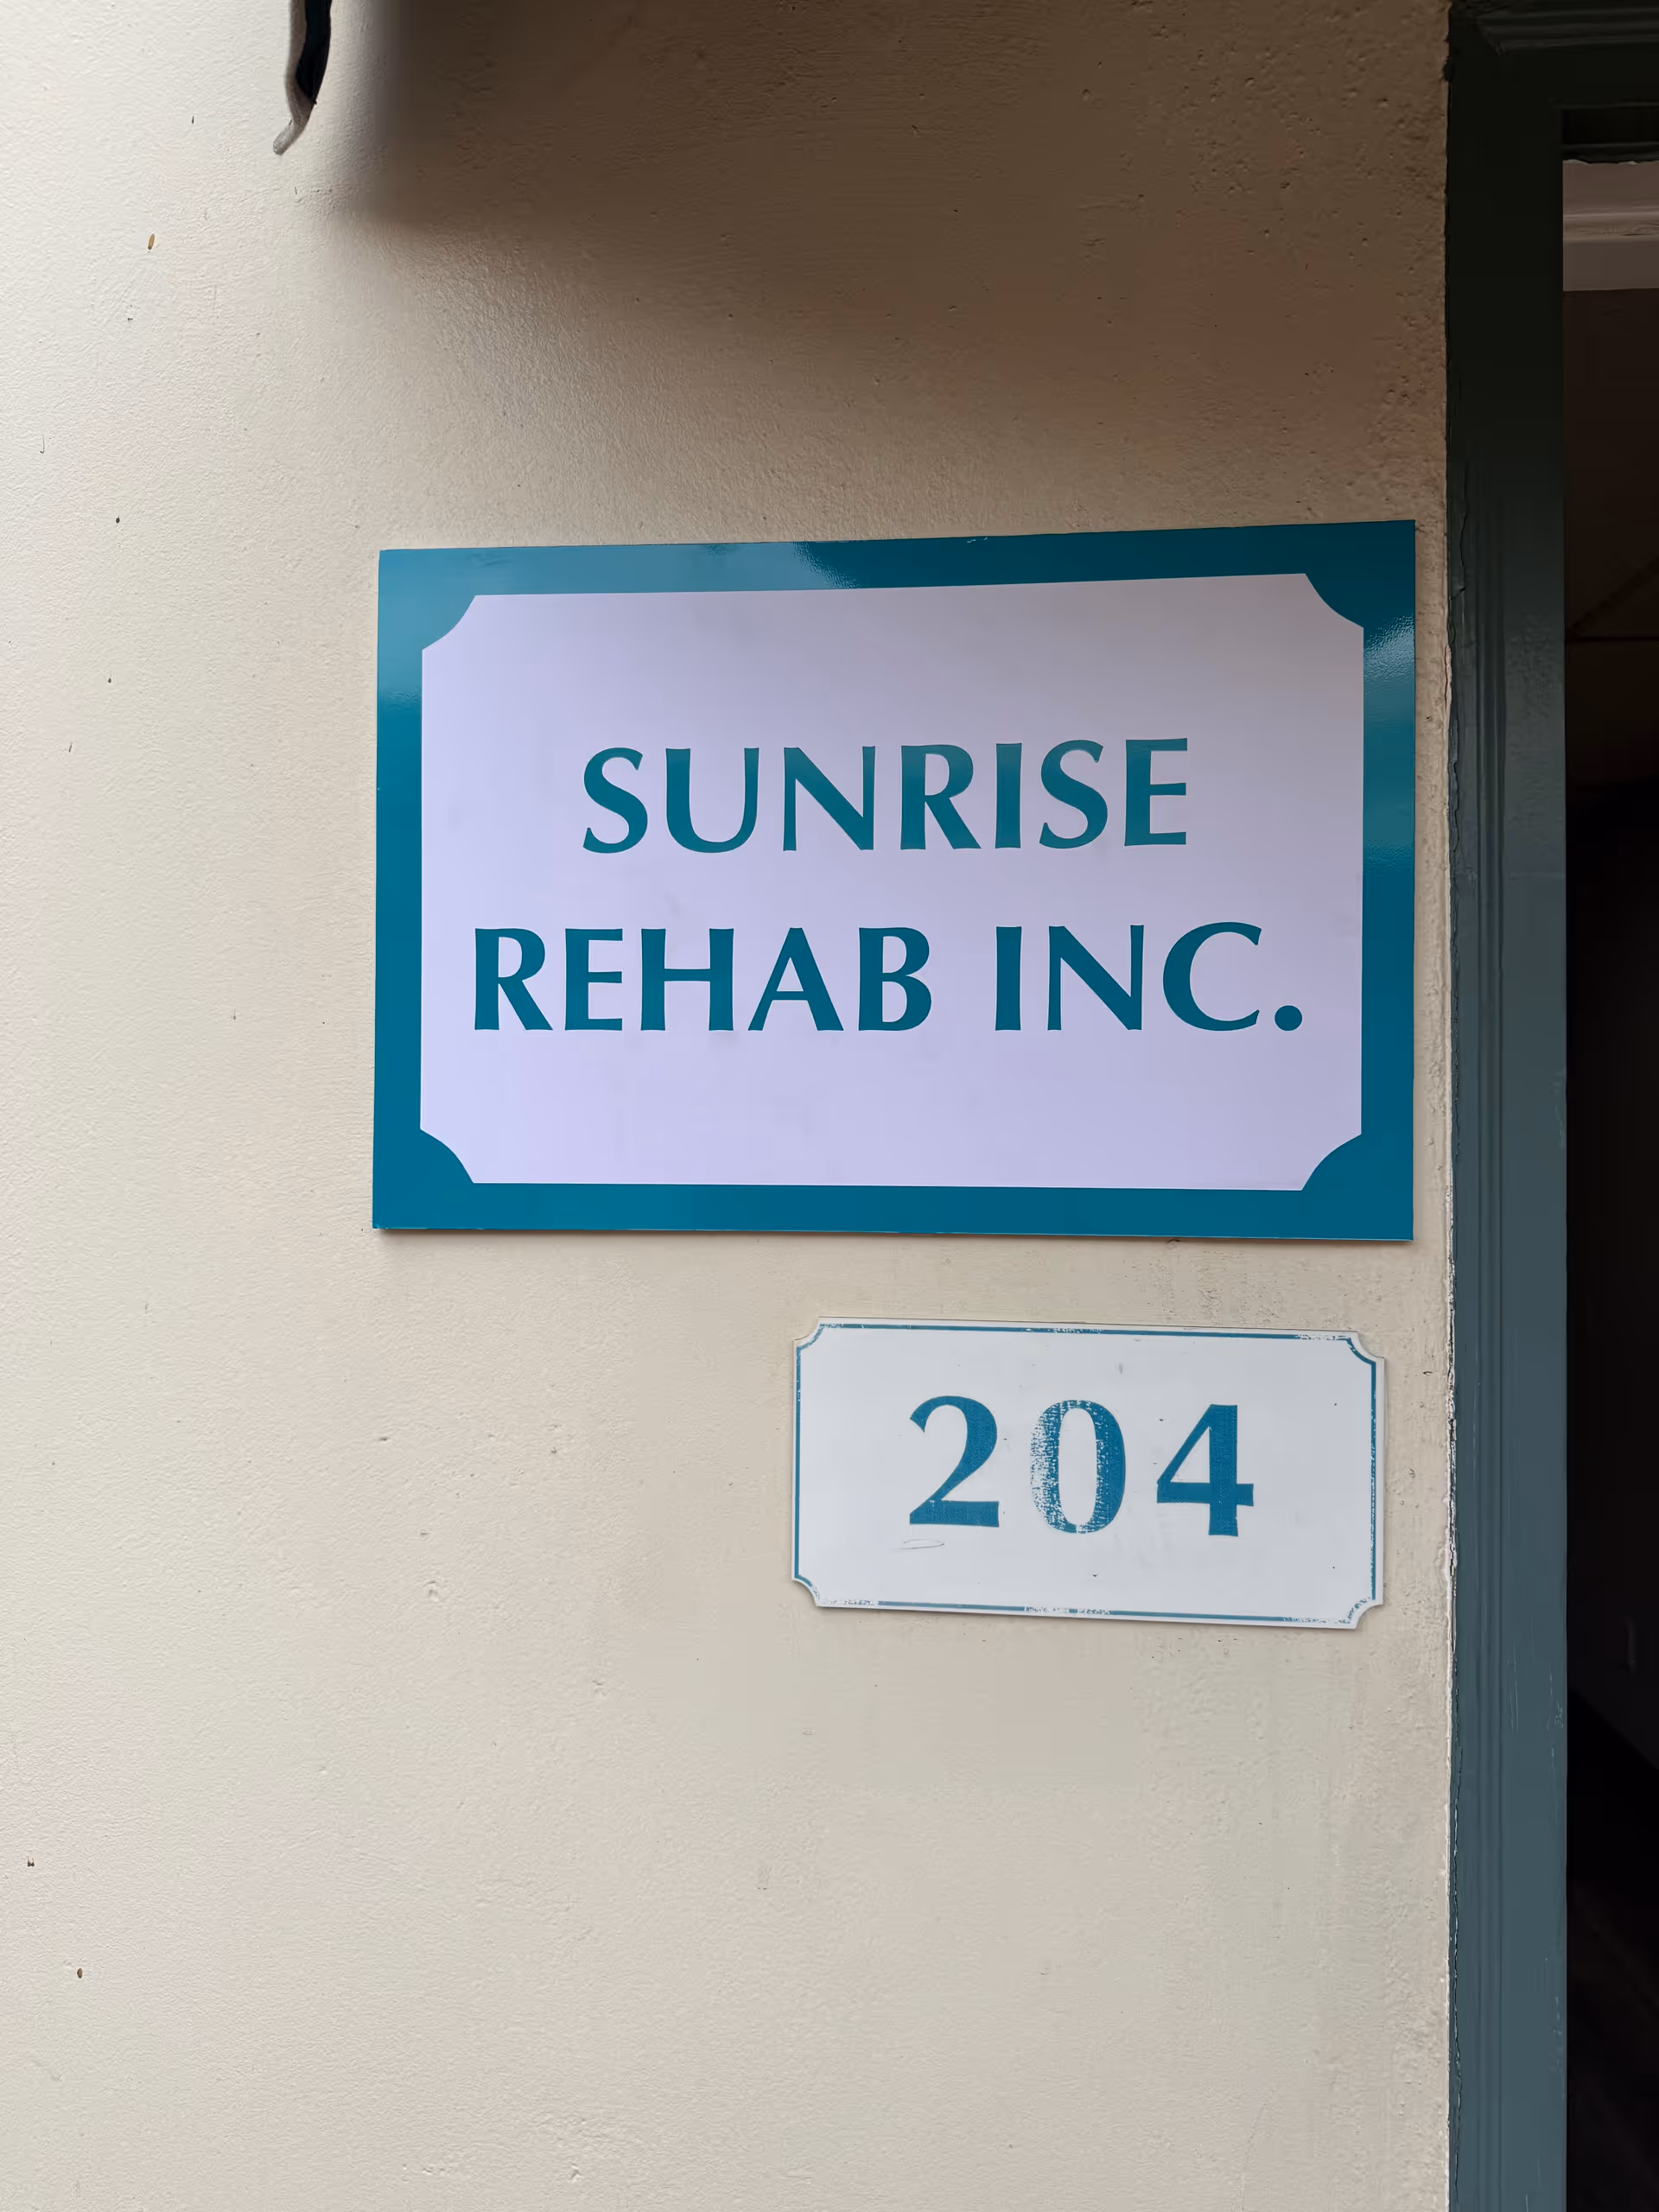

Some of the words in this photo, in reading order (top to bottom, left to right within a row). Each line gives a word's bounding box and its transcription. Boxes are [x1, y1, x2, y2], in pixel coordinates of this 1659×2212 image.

[582, 737, 1189, 854] SUNRISE
[473, 925, 933, 1033] REHAB
[994, 920, 1304, 1033] INC.
[909, 1395, 1255, 1538] 204
